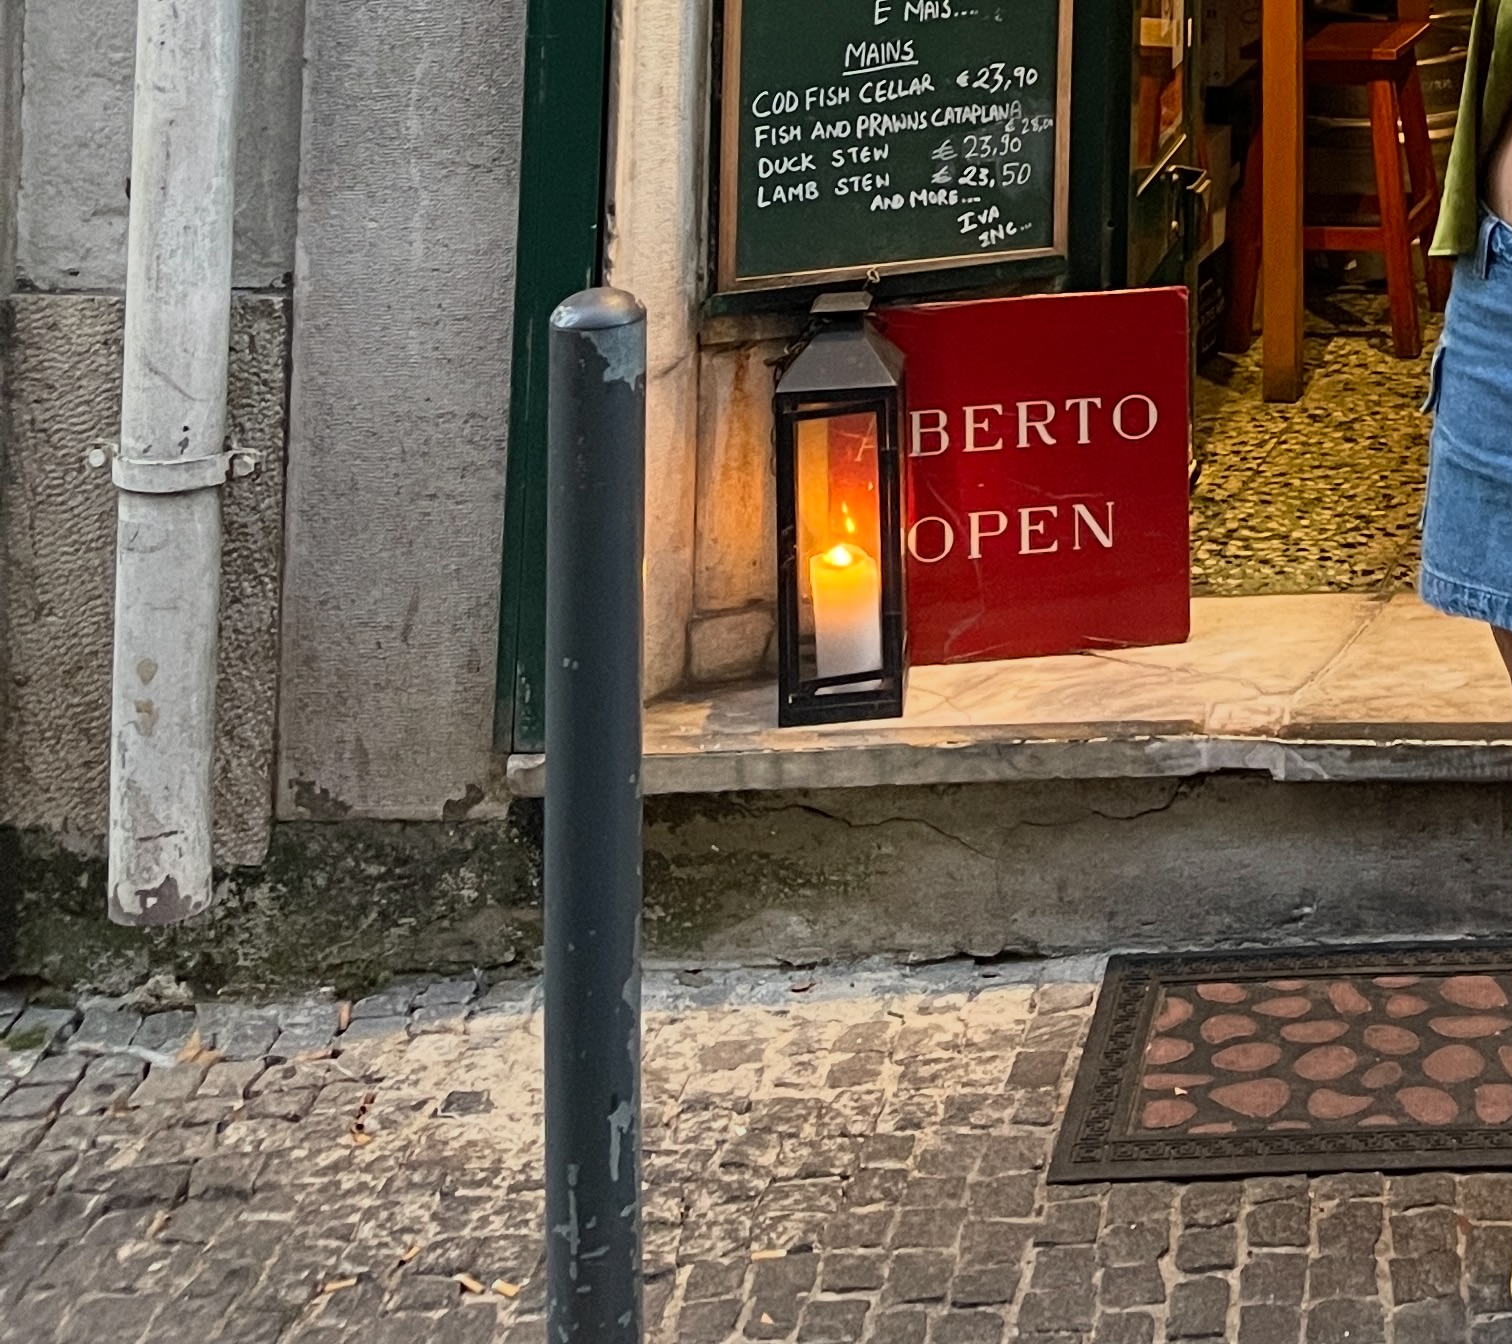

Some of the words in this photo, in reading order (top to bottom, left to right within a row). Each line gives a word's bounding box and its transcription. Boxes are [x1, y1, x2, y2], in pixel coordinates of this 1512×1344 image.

[845, 39, 915, 68] MAINS
[752, 90, 799, 118] COD
[805, 86, 850, 111] FISH
[859, 73, 935, 104] CELLAR
[755, 124, 801, 148] FISH
[811, 120, 851, 141] AND
[856, 111, 927, 139] PRAWNS
[931, 100, 1022, 126] CATAPLANA
[758, 152, 816, 179] DUCK
[831, 144, 889, 168] STEW
[757, 181, 819, 208] LAMB
[870, 194, 905, 212] AND
[957, 205, 1000, 234] IVA
[907, 502, 1116, 564] OPEN
